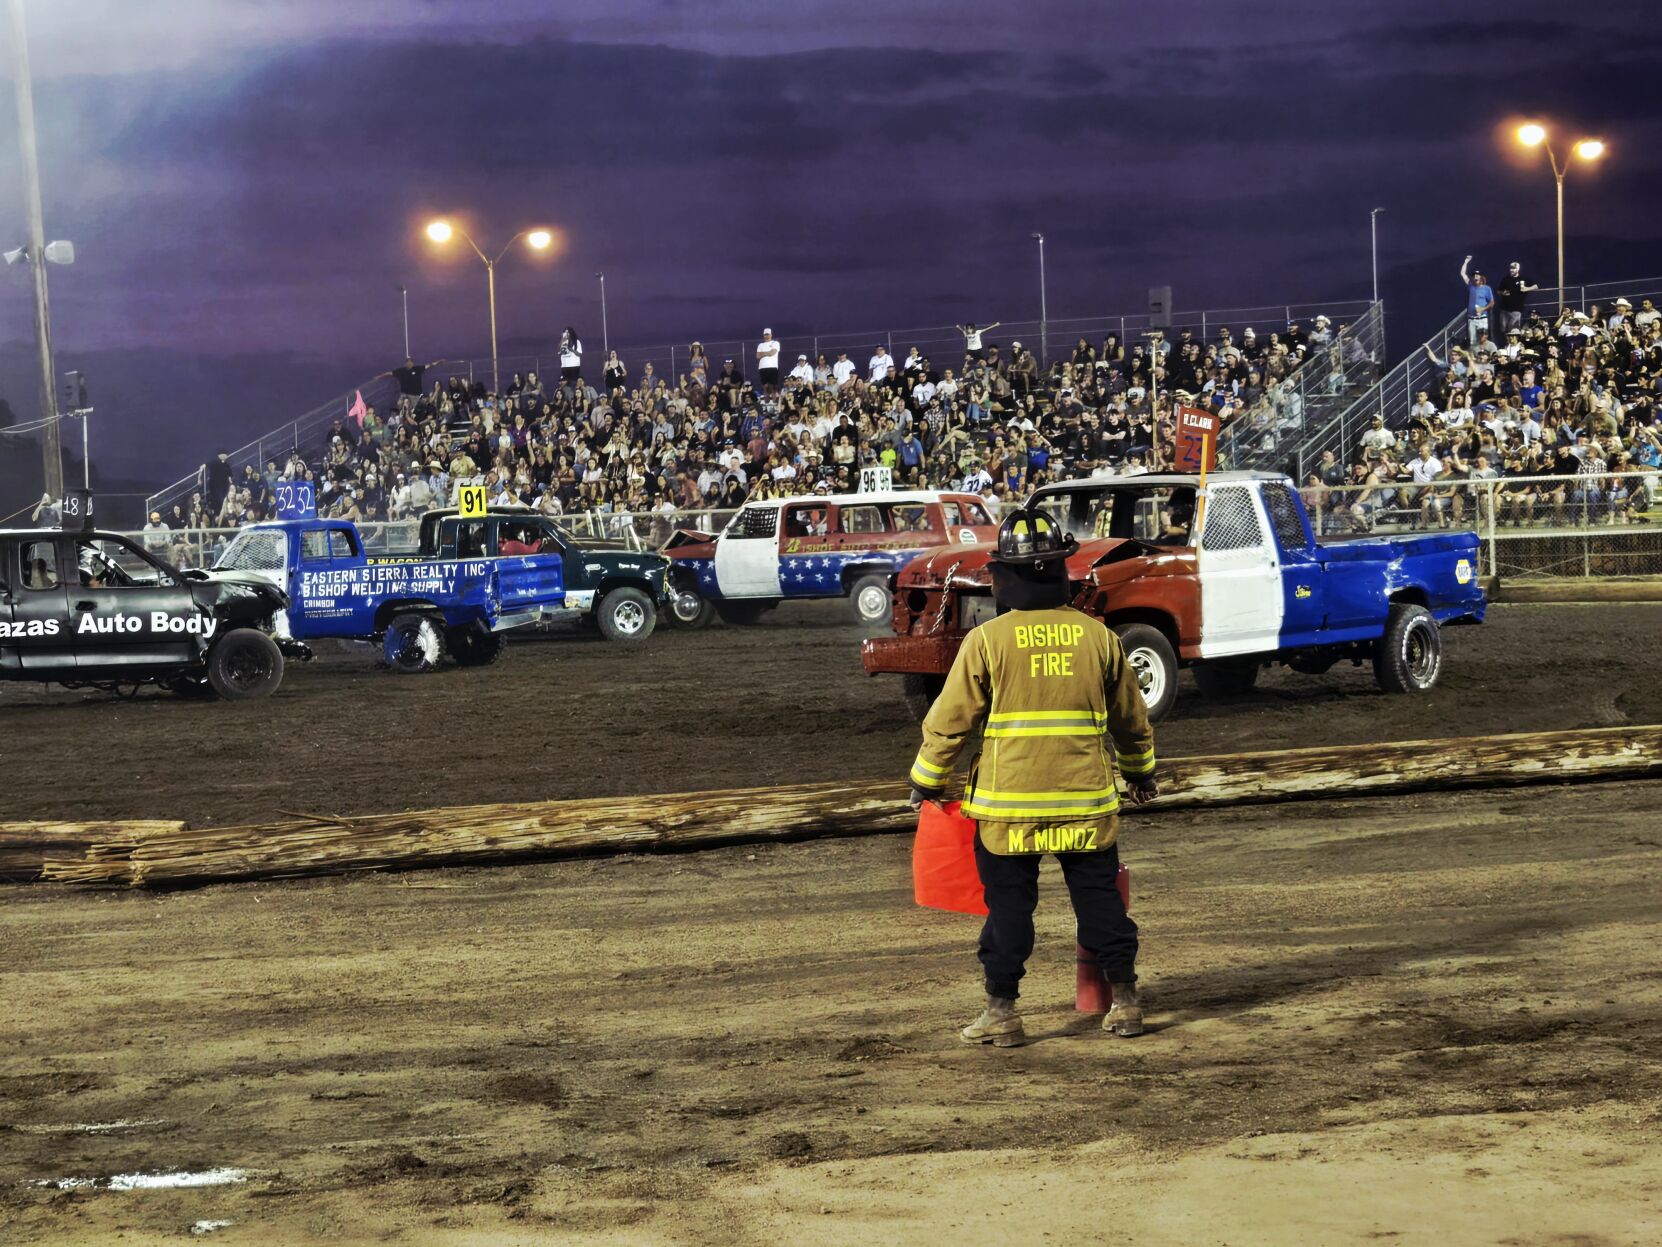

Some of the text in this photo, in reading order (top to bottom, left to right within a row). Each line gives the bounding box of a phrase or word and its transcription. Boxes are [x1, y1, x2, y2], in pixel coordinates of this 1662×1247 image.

[863, 470, 876, 492] 96
[63, 496, 79, 515] 18
[276, 486, 295, 511] 32
[297, 486, 314, 514] 32
[464, 489, 482, 513] 91
[303, 563, 486, 585] EASTERN SIERRA REALTY INC
[303, 580, 455, 598] BISHOP WELDING SUPPLY
[77, 612, 143, 634] Auto
[150, 611, 217, 638] Body
[1015, 624, 1084, 649] BISHOP
[1030, 652, 1074, 678] FIRE
[1008, 827, 1098, 853] M. MUNOZ
